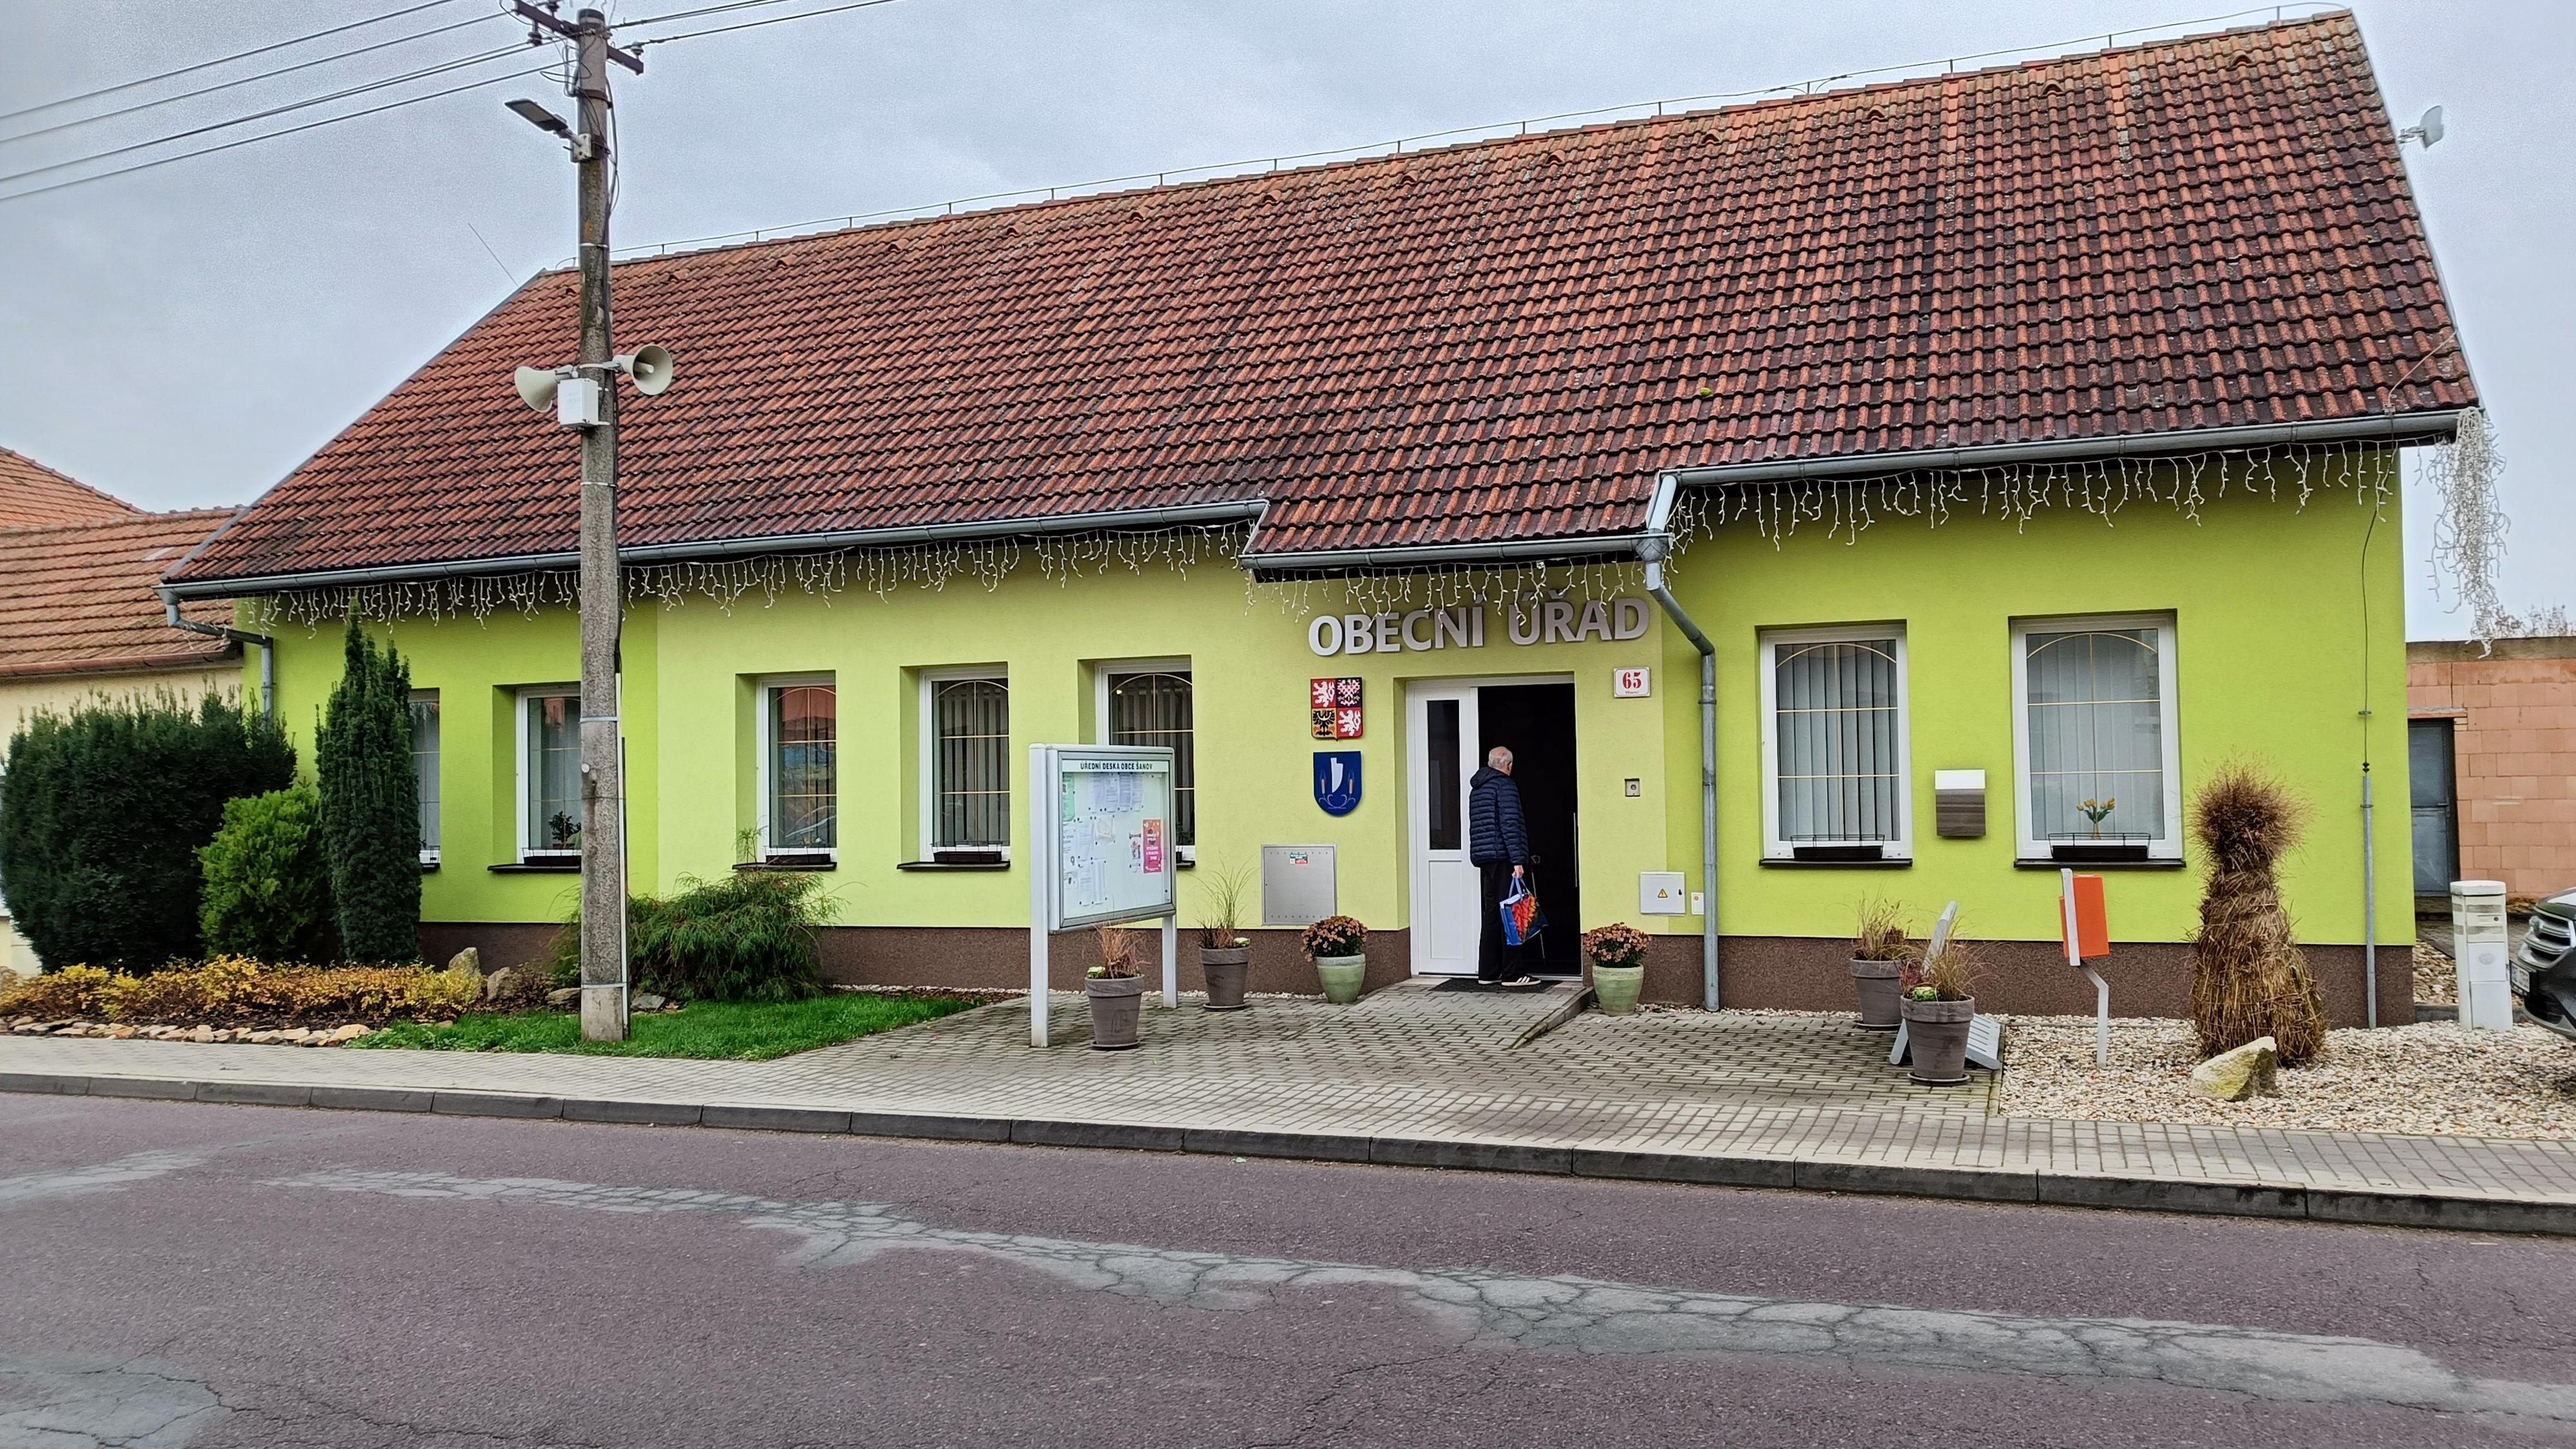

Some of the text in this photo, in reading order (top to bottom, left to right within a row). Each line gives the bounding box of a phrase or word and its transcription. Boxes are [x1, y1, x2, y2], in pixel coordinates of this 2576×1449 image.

[1308, 589, 1650, 656] OBECNÍ ÚŘAD
[1622, 672, 1642, 689] 65
[1080, 760, 1101, 770] ÚŘEDNÍ
[1136, 760, 1153, 770] ŠANOV
